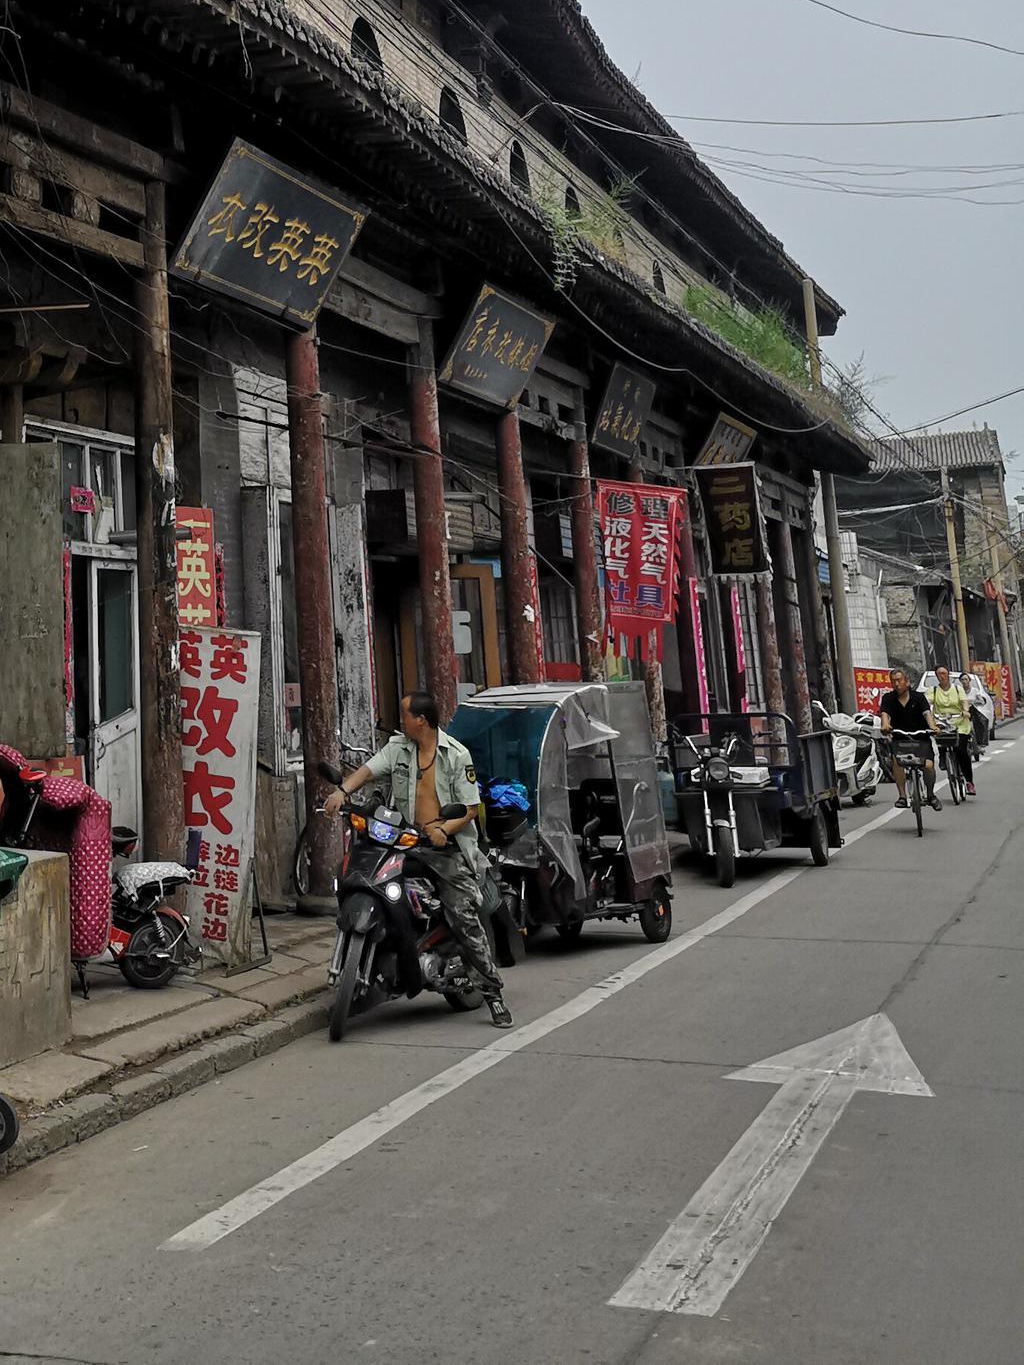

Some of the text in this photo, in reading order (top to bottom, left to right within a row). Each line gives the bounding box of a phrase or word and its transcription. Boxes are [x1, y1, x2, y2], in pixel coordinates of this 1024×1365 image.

[606, 491, 669, 522] 修理
[604, 516, 632, 579] 液化气
[640, 521, 669, 585] 天然气
[180, 685, 238, 835] 改衣
[201, 892, 228, 942] 花边
